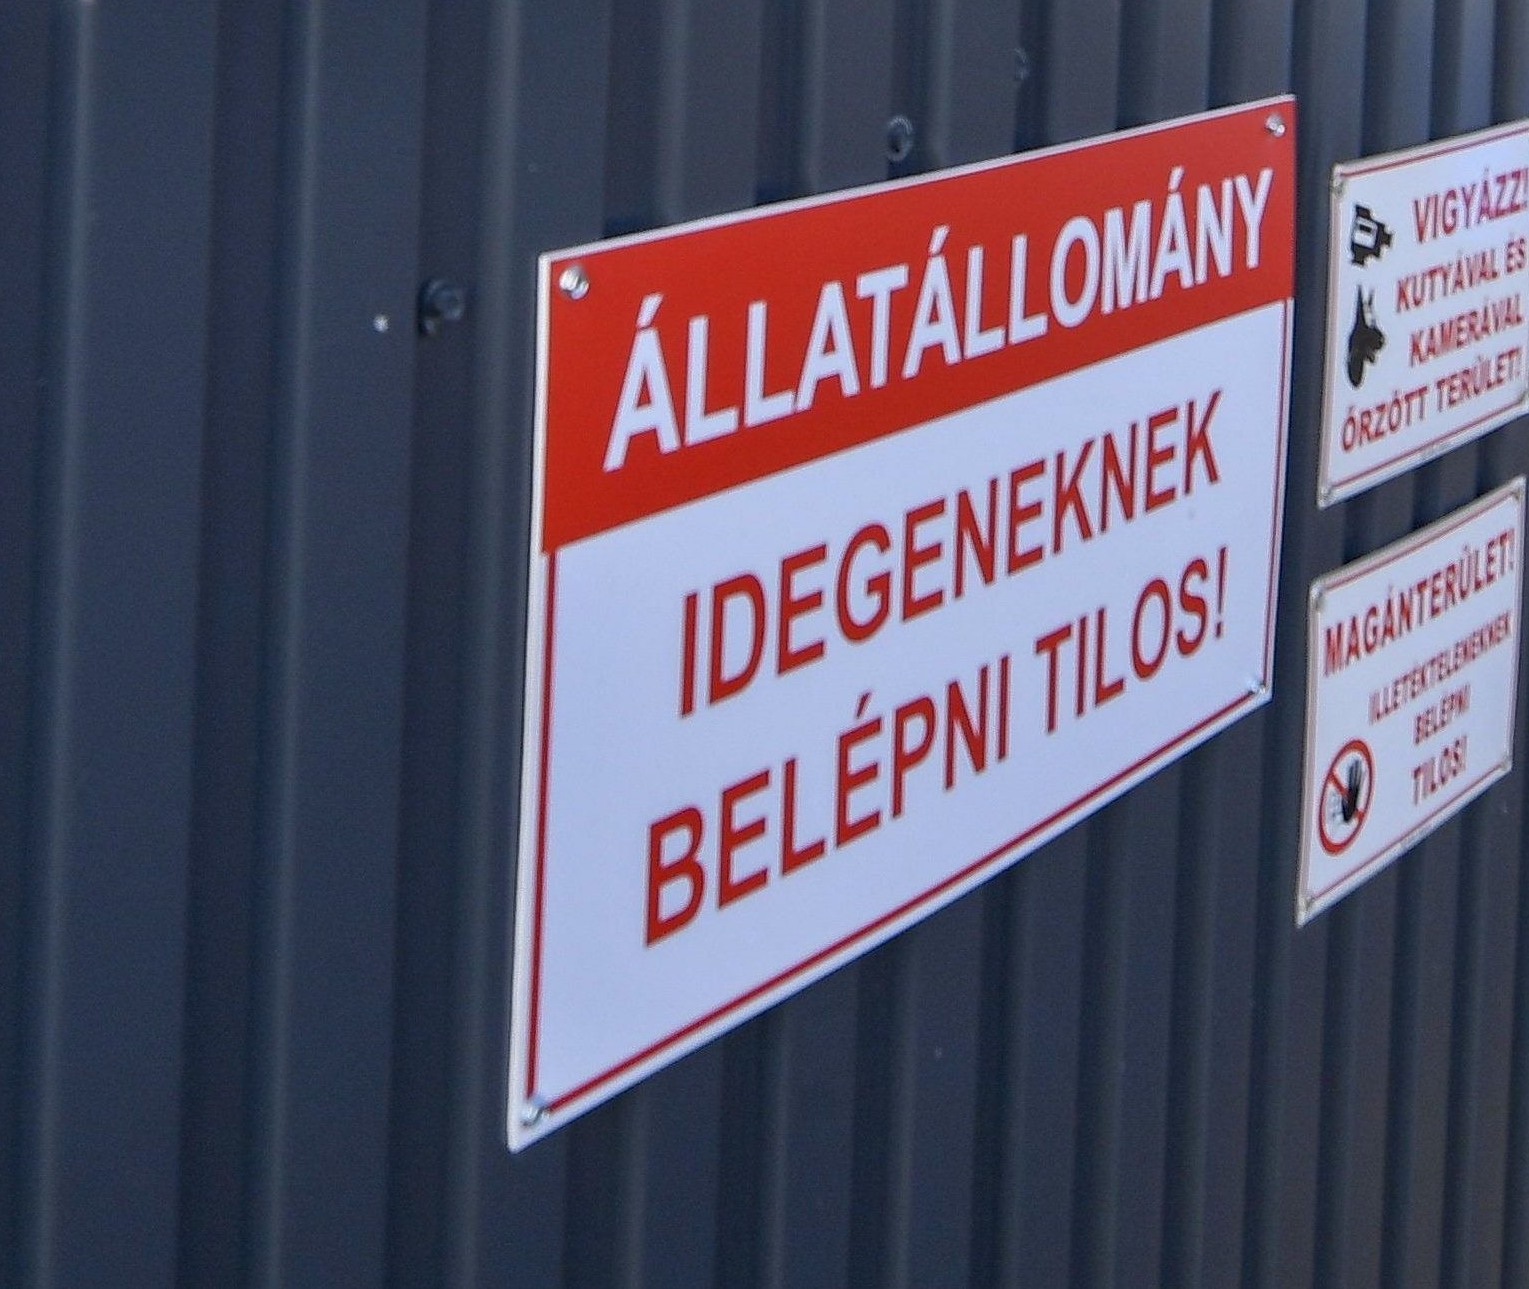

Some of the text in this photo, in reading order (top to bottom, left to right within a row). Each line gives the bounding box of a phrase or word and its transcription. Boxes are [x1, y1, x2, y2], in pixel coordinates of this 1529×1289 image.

[1396, 232, 1527, 313] KUTYÁVAL ÉS
[1412, 167, 1529, 244] VIGYÁZZ!
[601, 167, 1274, 474] ÁLLATÁLLOMÁNY
[1409, 292, 1525, 367] KAMERÁVAL
[678, 388, 1224, 717] IDEGENEKNEK
[644, 546, 1229, 948] BELÉPNI TILOS!
